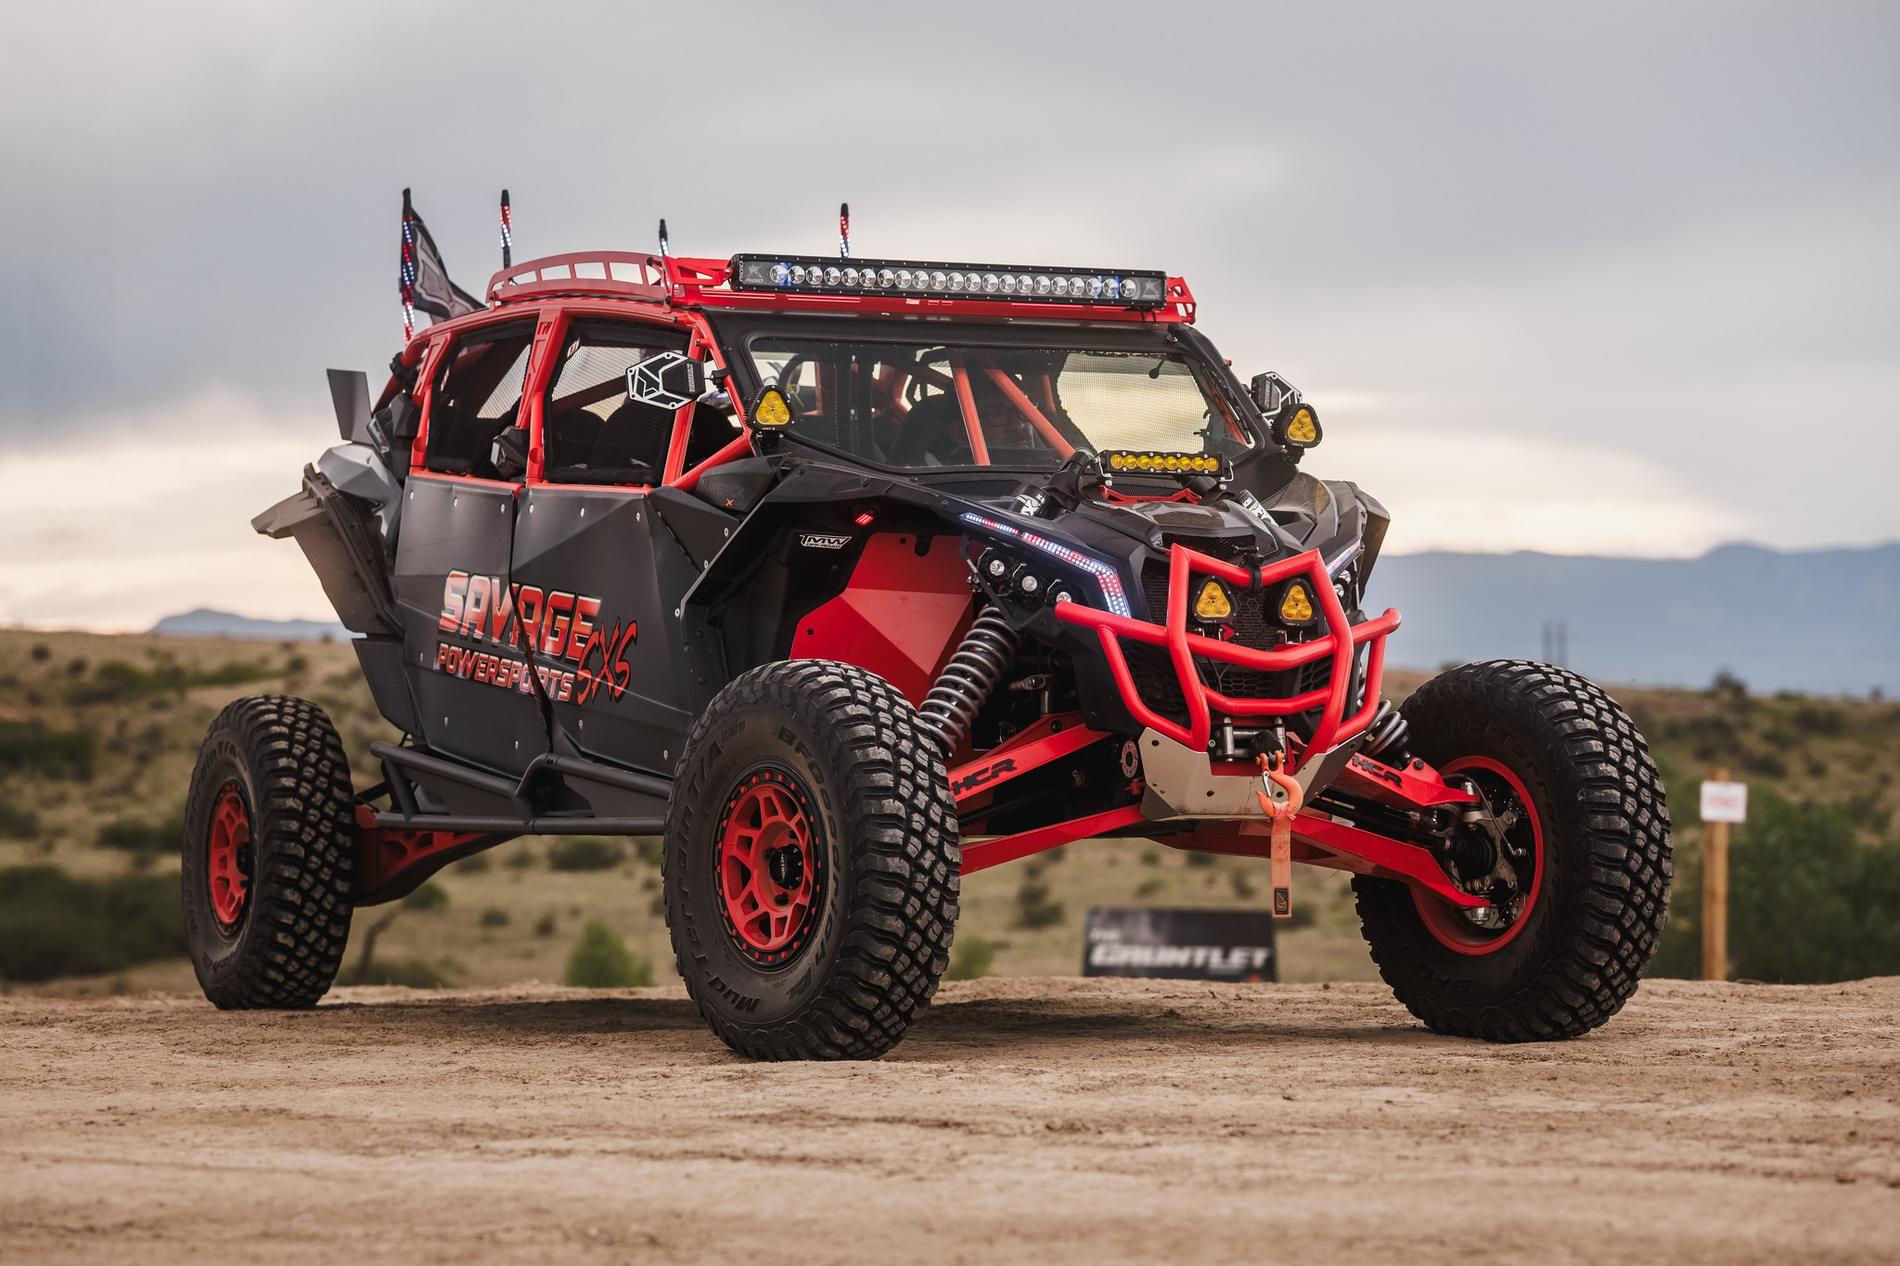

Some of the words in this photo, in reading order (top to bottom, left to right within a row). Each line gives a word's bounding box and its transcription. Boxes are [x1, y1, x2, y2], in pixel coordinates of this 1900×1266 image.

[438, 569, 602, 662] SAVAGE
[435, 642, 575, 703] POWERSPORTS
[951, 757, 1018, 796] HCR
[1352, 754, 1404, 789] HCR
[1089, 944, 1269, 972] GAUNTLET
